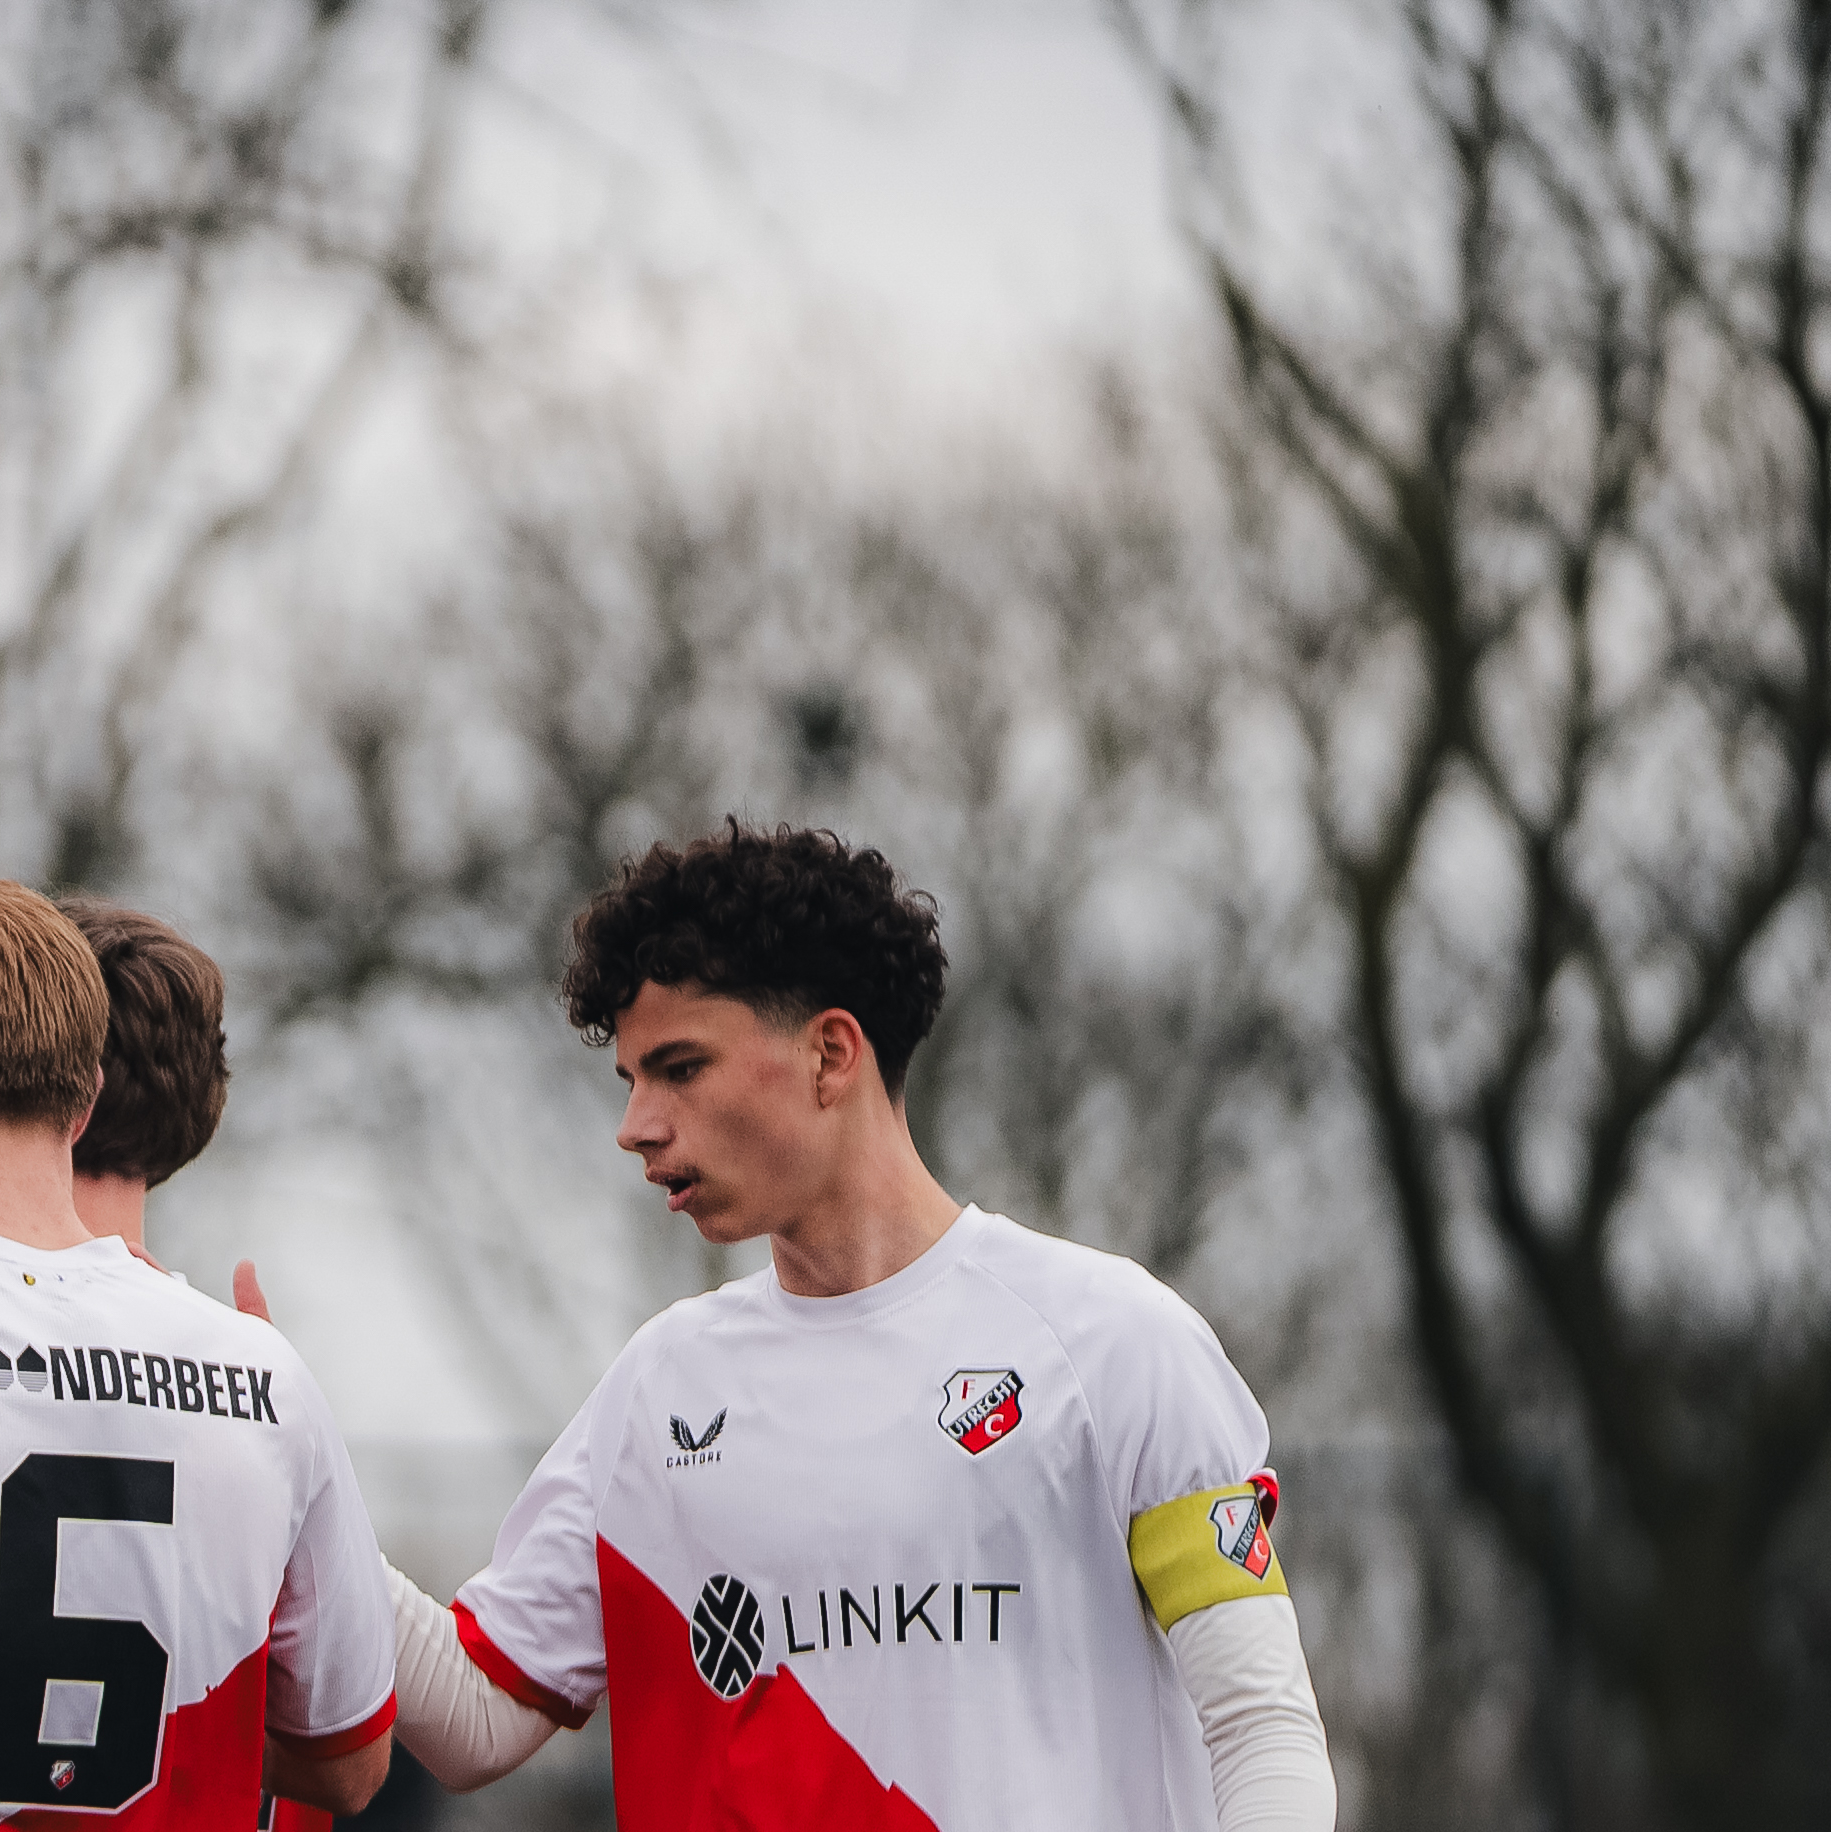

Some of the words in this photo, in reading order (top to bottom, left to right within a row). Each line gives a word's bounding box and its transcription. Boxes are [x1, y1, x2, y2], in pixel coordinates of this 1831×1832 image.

[961, 1378, 976, 1399] F
[947, 1372, 1018, 1440] UTRECHT
[984, 1413, 1005, 1439] C
[666, 1451, 722, 1468] CASTORE
[1225, 1505, 1238, 1526] F
[1253, 1538, 1269, 1561] C
[781, 1581, 1021, 1655] LINKIT
